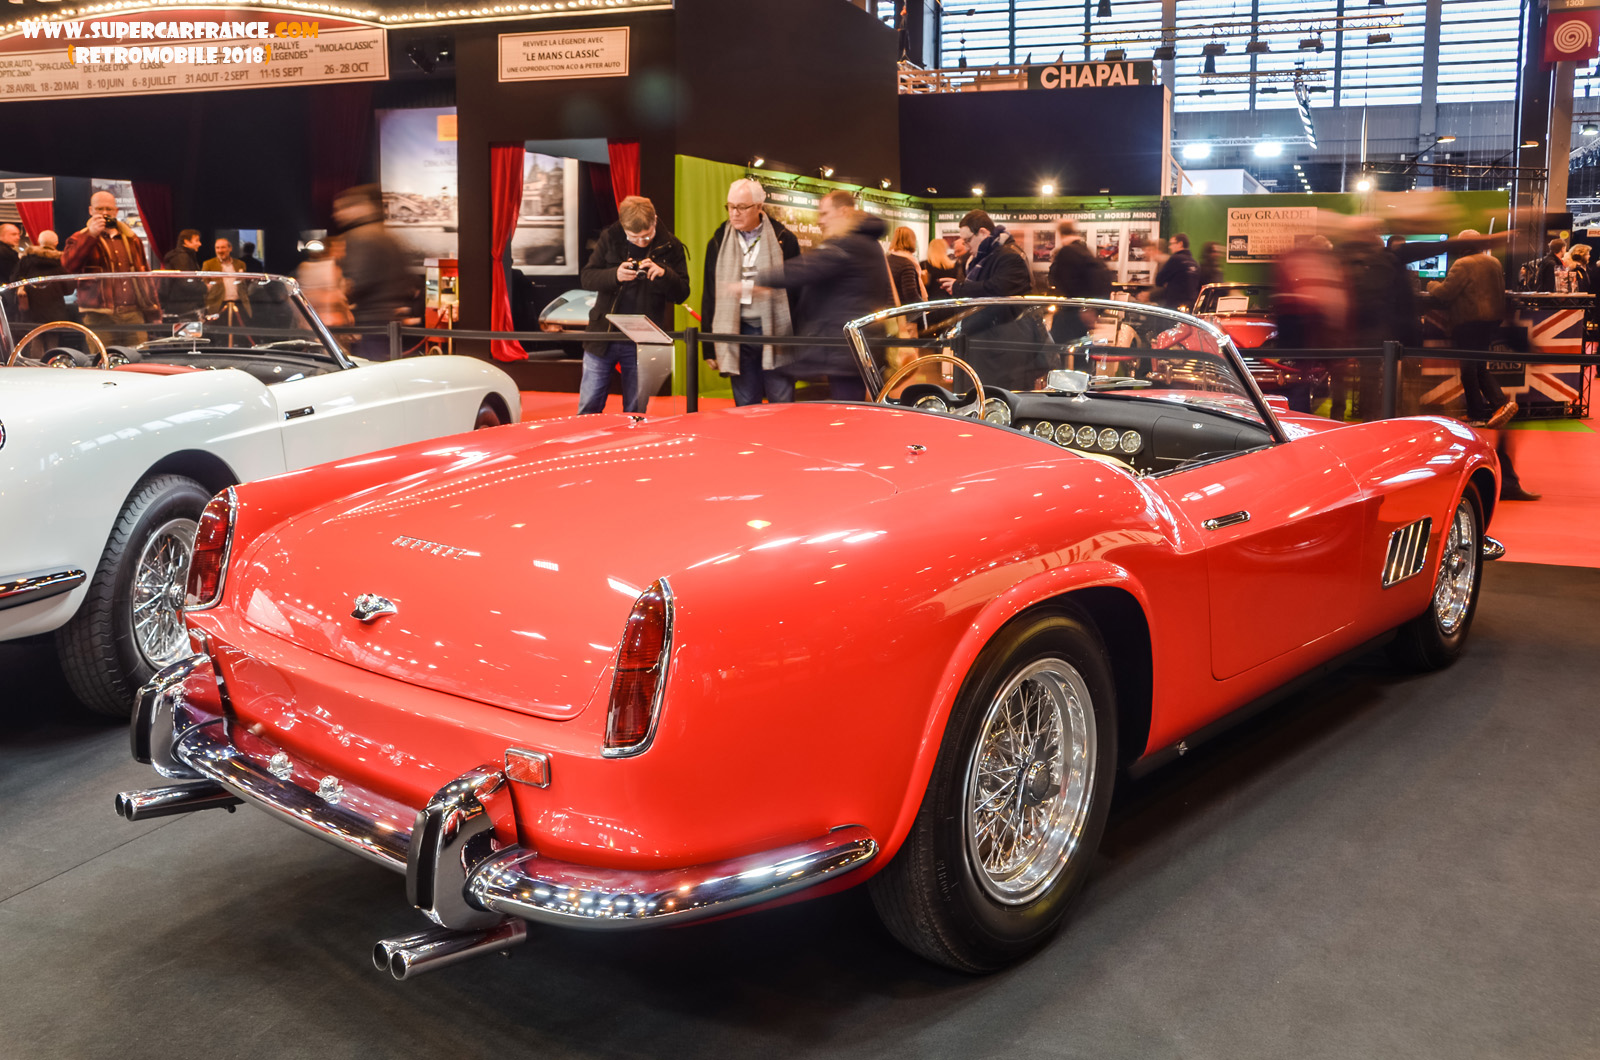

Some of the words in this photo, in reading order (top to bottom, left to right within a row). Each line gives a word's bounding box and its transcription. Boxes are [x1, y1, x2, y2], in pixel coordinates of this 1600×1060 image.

[273, 41, 299, 50] RALLYE
[558, 37, 586, 45] LÉGENDE
[587, 36, 604, 44] AVEC
[538, 51, 563, 60] MANS
[15, 59, 33, 68] AUTO
[324, 64, 334, 74] 26
[340, 63, 350, 73] 28
[351, 62, 369, 72] OCT
[519, 64, 565, 72] COPRODUCTION
[83, 65, 92, 73] DE
[282, 66, 304, 77] SEPT
[185, 73, 194, 83] 31
[195, 72, 219, 83] AOUT
[231, 70, 249, 80] SEPT
[1040, 62, 1140, 90] CHAPAL
[40, 82, 49, 91] 18
[54, 82, 63, 91] 20
[63, 81, 79, 90] MAI
[97, 79, 106, 88] 10
[106, 78, 124, 90] JUIN
[147, 75, 177, 88] JUILLET
[6, 84, 15, 93] 28
[16, 83, 37, 92] AVRIL
[1062, 212, 1096, 220] DEFENDER
[1104, 211, 1131, 220] MORRIS
[1132, 211, 1157, 219] MINOR
[1230, 210, 1252, 223] Guy
